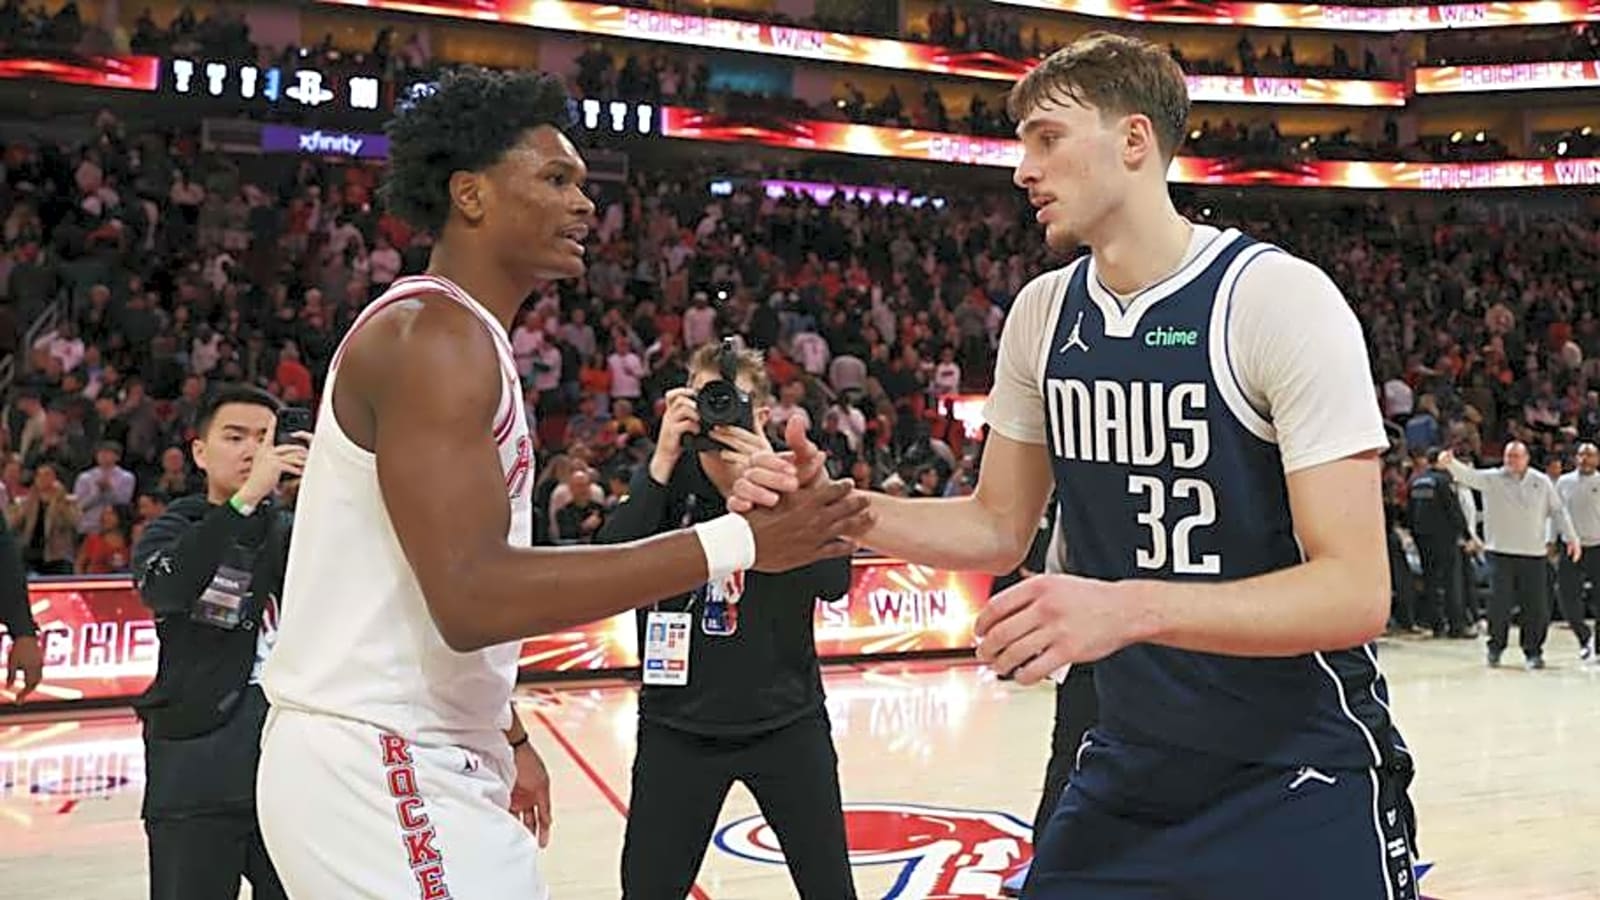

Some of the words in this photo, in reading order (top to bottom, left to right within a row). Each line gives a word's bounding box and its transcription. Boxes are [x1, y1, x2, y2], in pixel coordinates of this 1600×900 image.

[299, 130, 364, 156] xfinity
[1145, 326, 1198, 346] chime
[1047, 378, 1210, 470] MAVS
[1128, 474, 1221, 575] 32
[868, 589, 948, 628] WIN
[379, 733, 451, 900] ROCKE
